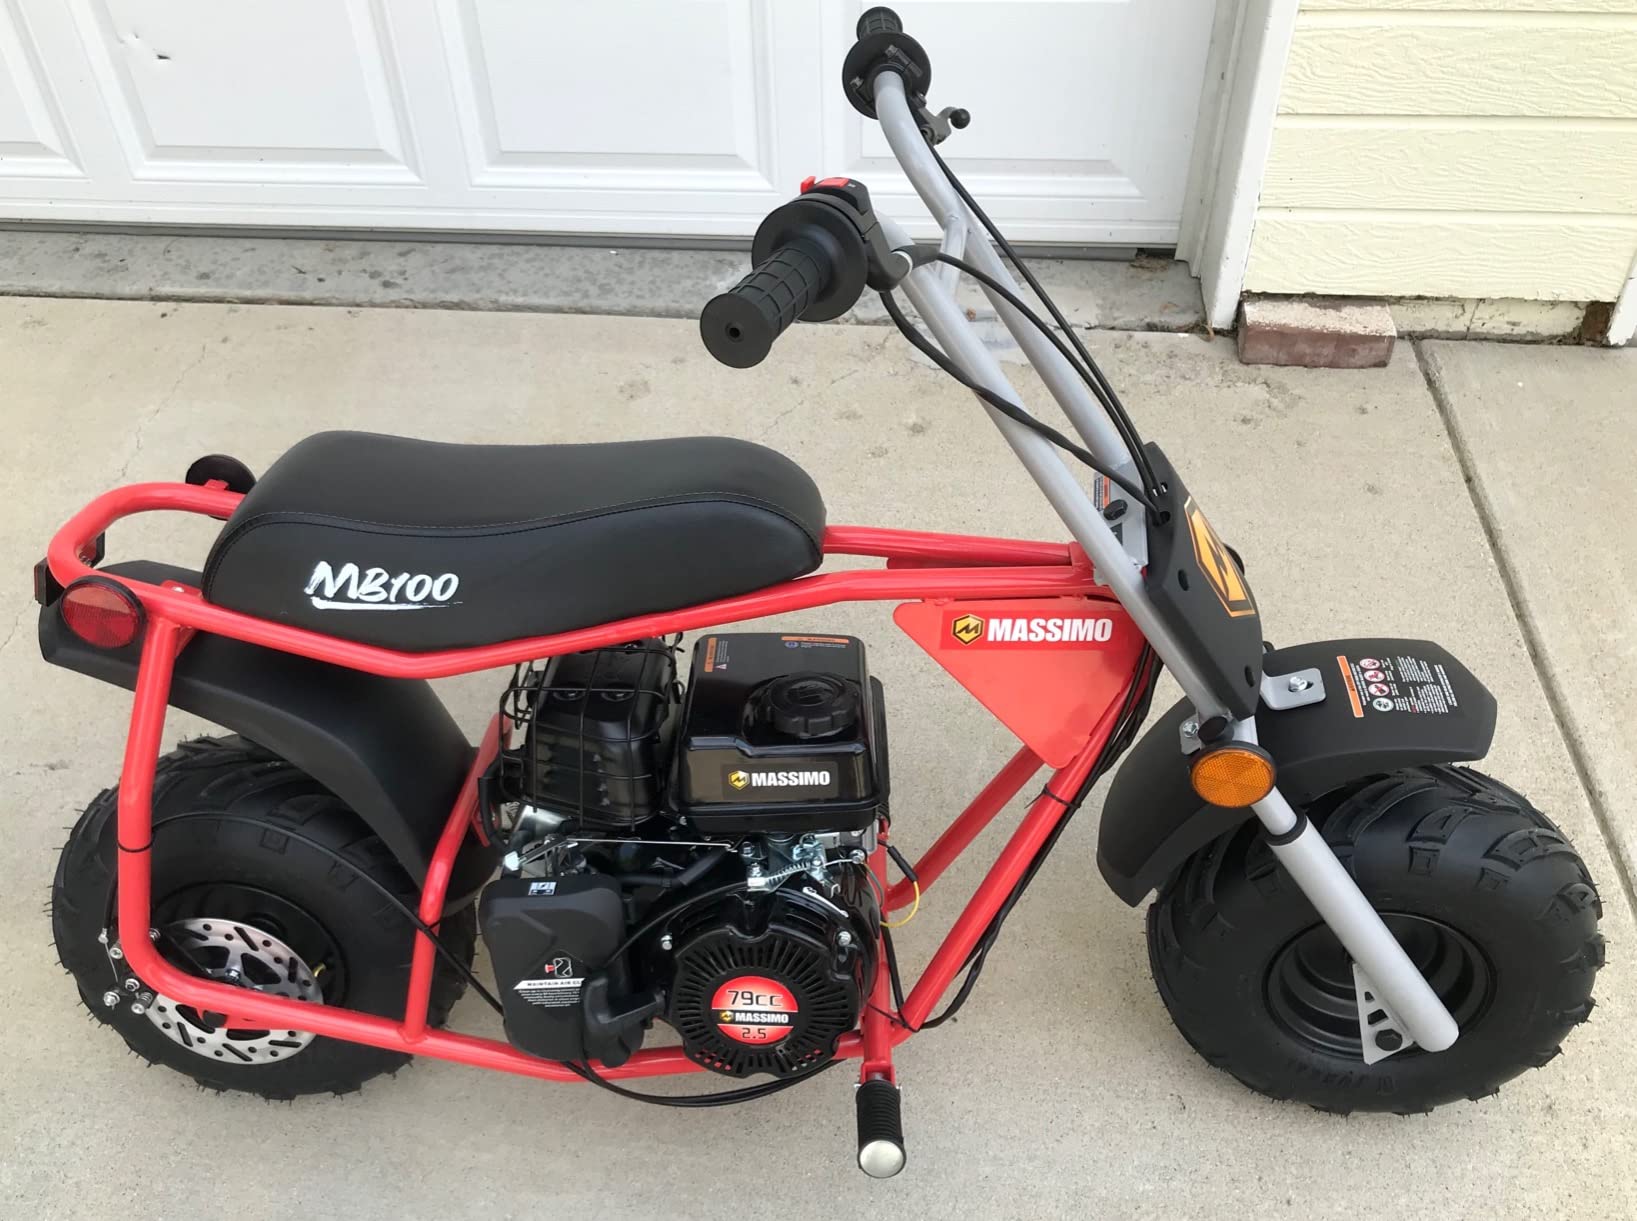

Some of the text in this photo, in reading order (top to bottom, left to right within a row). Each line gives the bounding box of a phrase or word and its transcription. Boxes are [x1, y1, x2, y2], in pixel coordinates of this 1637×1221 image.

[303, 561, 460, 603] MB100
[987, 618, 1113, 642] MASSIMO
[751, 771, 831, 787] MASSIMO
[735, 1012, 789, 1024] MASSIMO
[741, 1027, 767, 1040] 2.5
